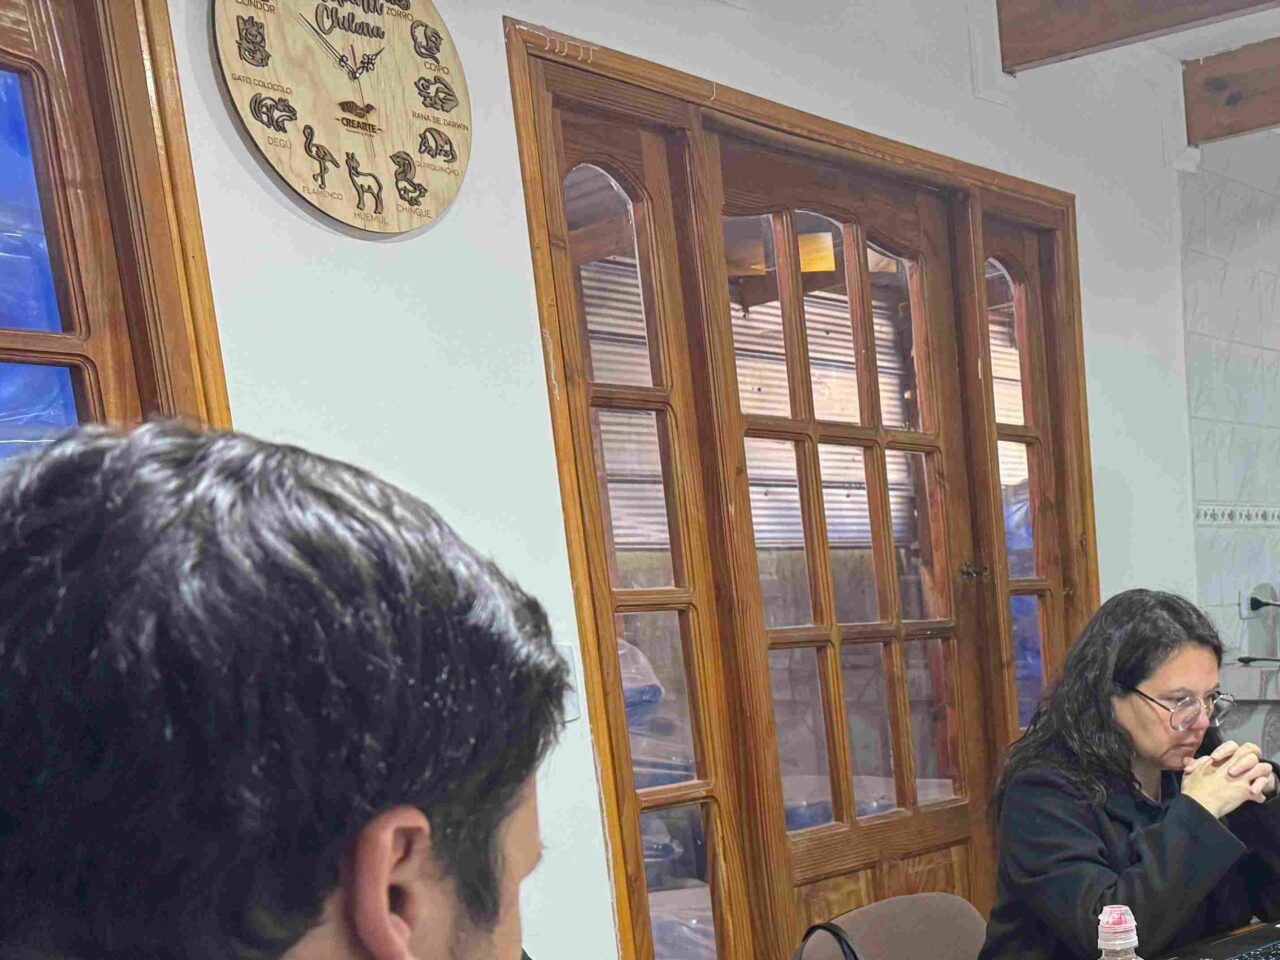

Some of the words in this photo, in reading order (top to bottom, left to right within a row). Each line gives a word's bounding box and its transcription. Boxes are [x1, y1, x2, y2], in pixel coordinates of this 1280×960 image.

[386, 6, 414, 21] ZORRO
[424, 61, 450, 75] COIPO
[411, 110, 431, 122] RANA
[302, 185, 343, 201] FLAMENCO
